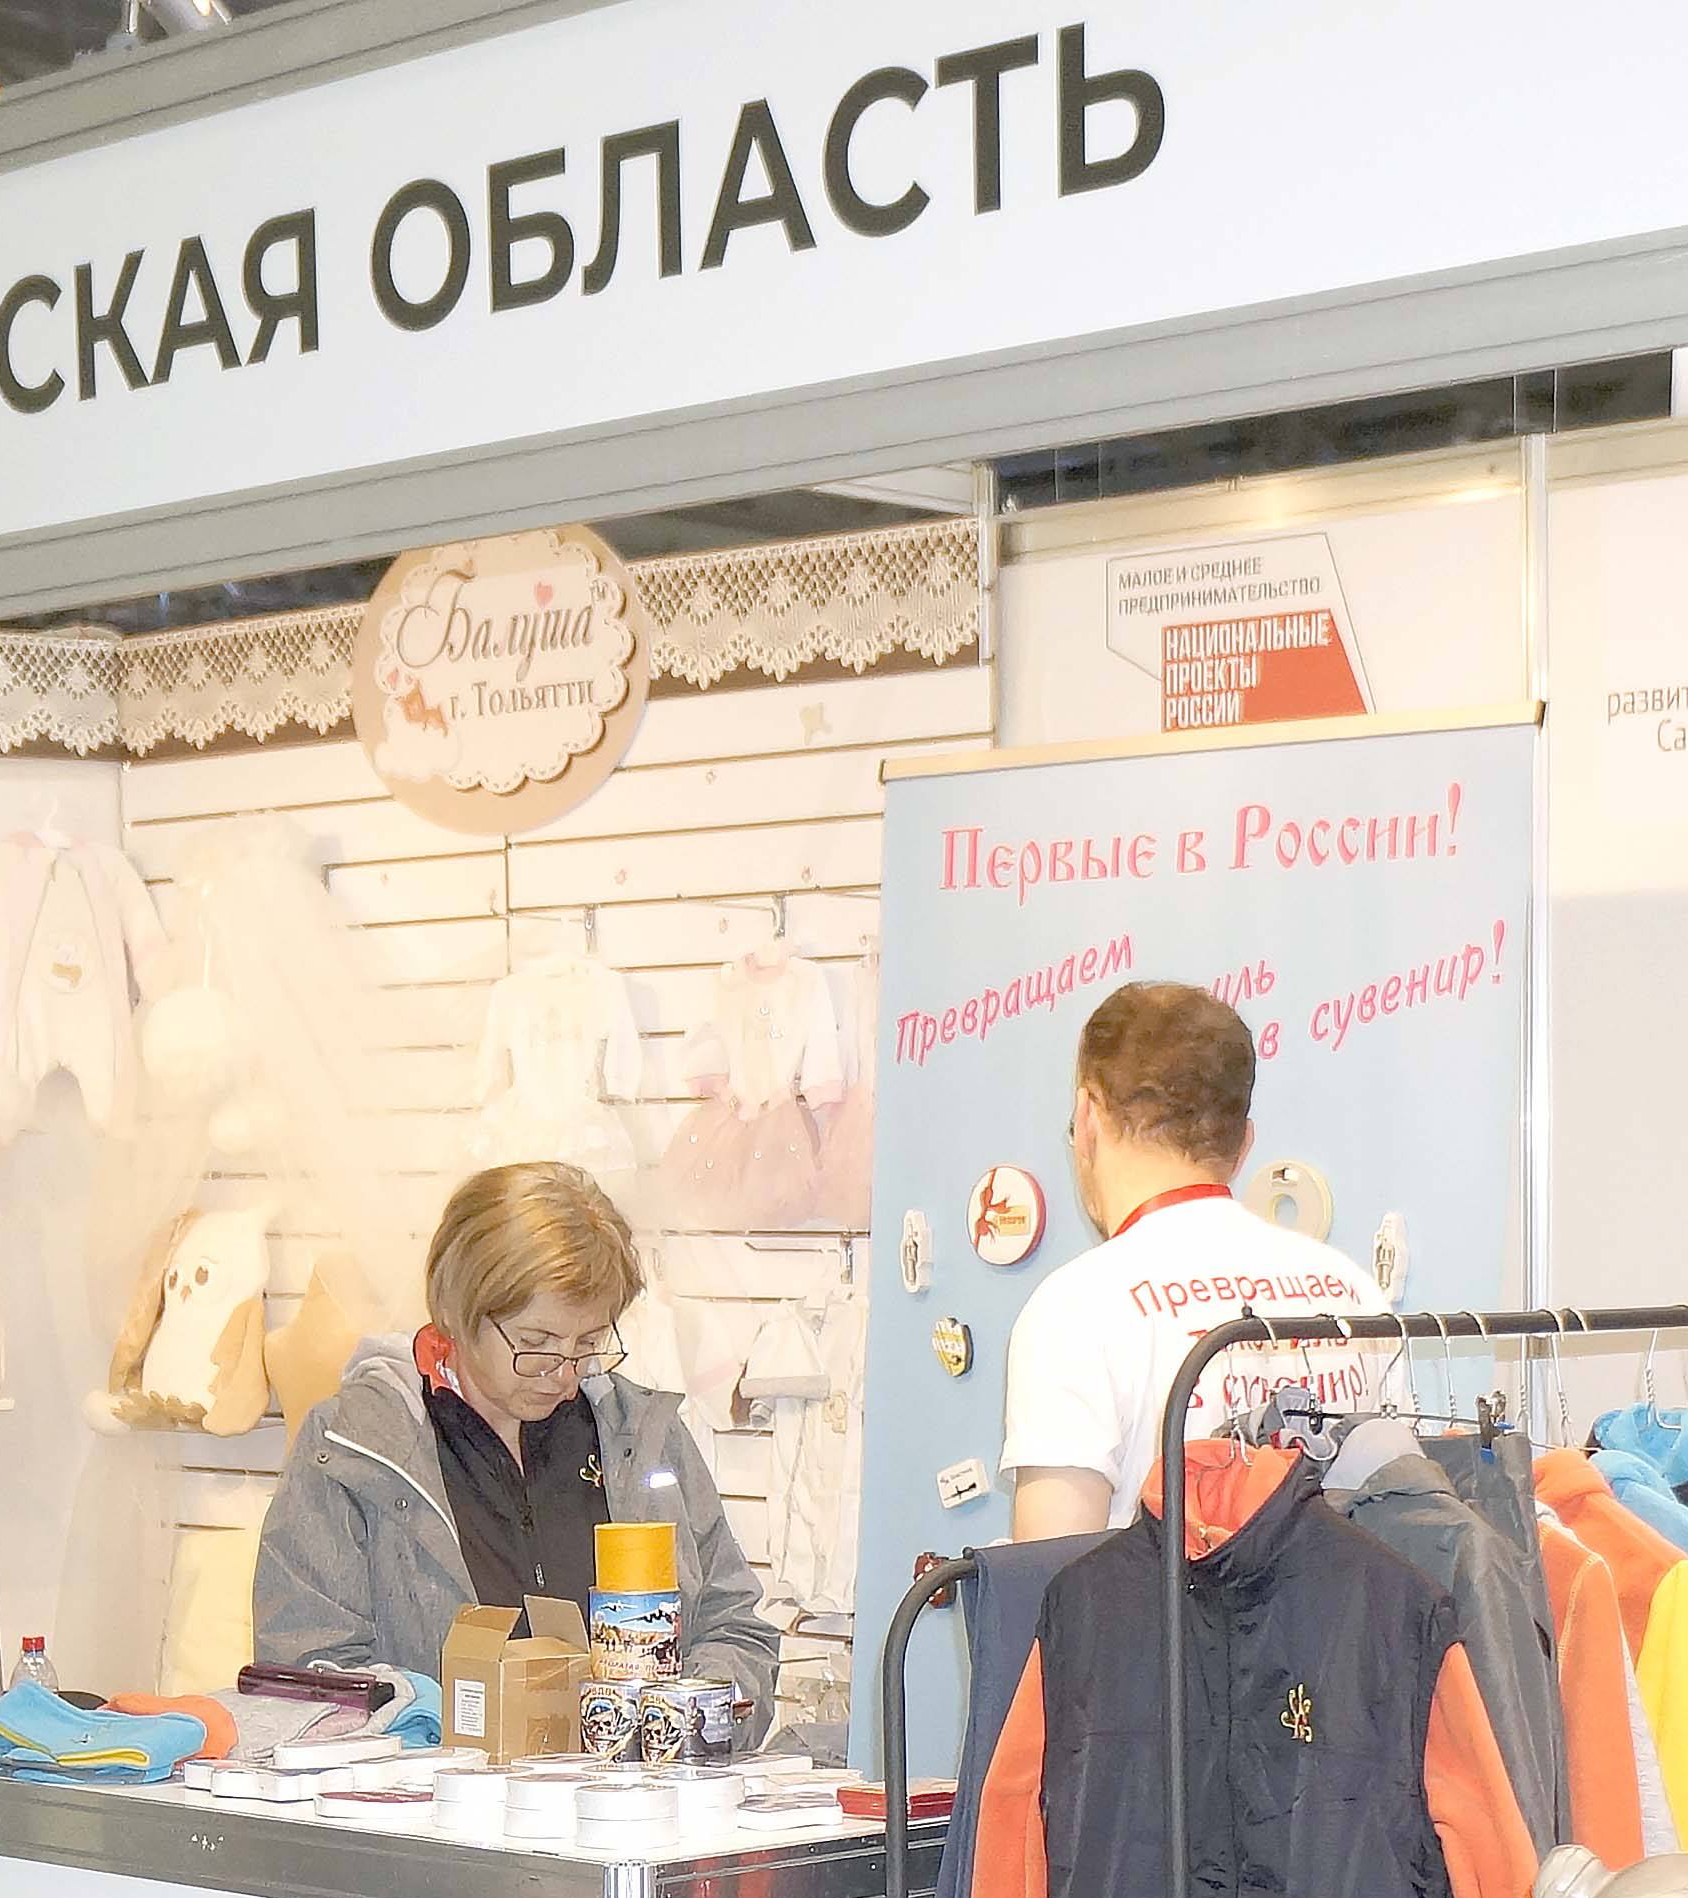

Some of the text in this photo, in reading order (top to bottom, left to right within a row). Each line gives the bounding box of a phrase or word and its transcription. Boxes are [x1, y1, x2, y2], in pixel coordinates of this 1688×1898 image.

[370, 20, 1165, 333] ОБЛАСТЬ
[1118, 556, 1263, 590] МАЛОЕ И СРЕДНЕЕ
[1118, 575, 1322, 617] ПРЕДПРИНИМАТЕЛЬСТВО
[1165, 611, 1331, 662] НАЦИОНАЛЬНЫЕ
[472, 679, 594, 717] Тольятти
[1165, 656, 1257, 696] ПРОЕКТЫ
[1165, 690, 1242, 730] РОССИИ
[937, 782, 1462, 906] Первые в России!
[895, 932, 1134, 1066] Превращаем
[1258, 1020, 1281, 1060] в
[1310, 919, 1507, 1053] сувенир!
